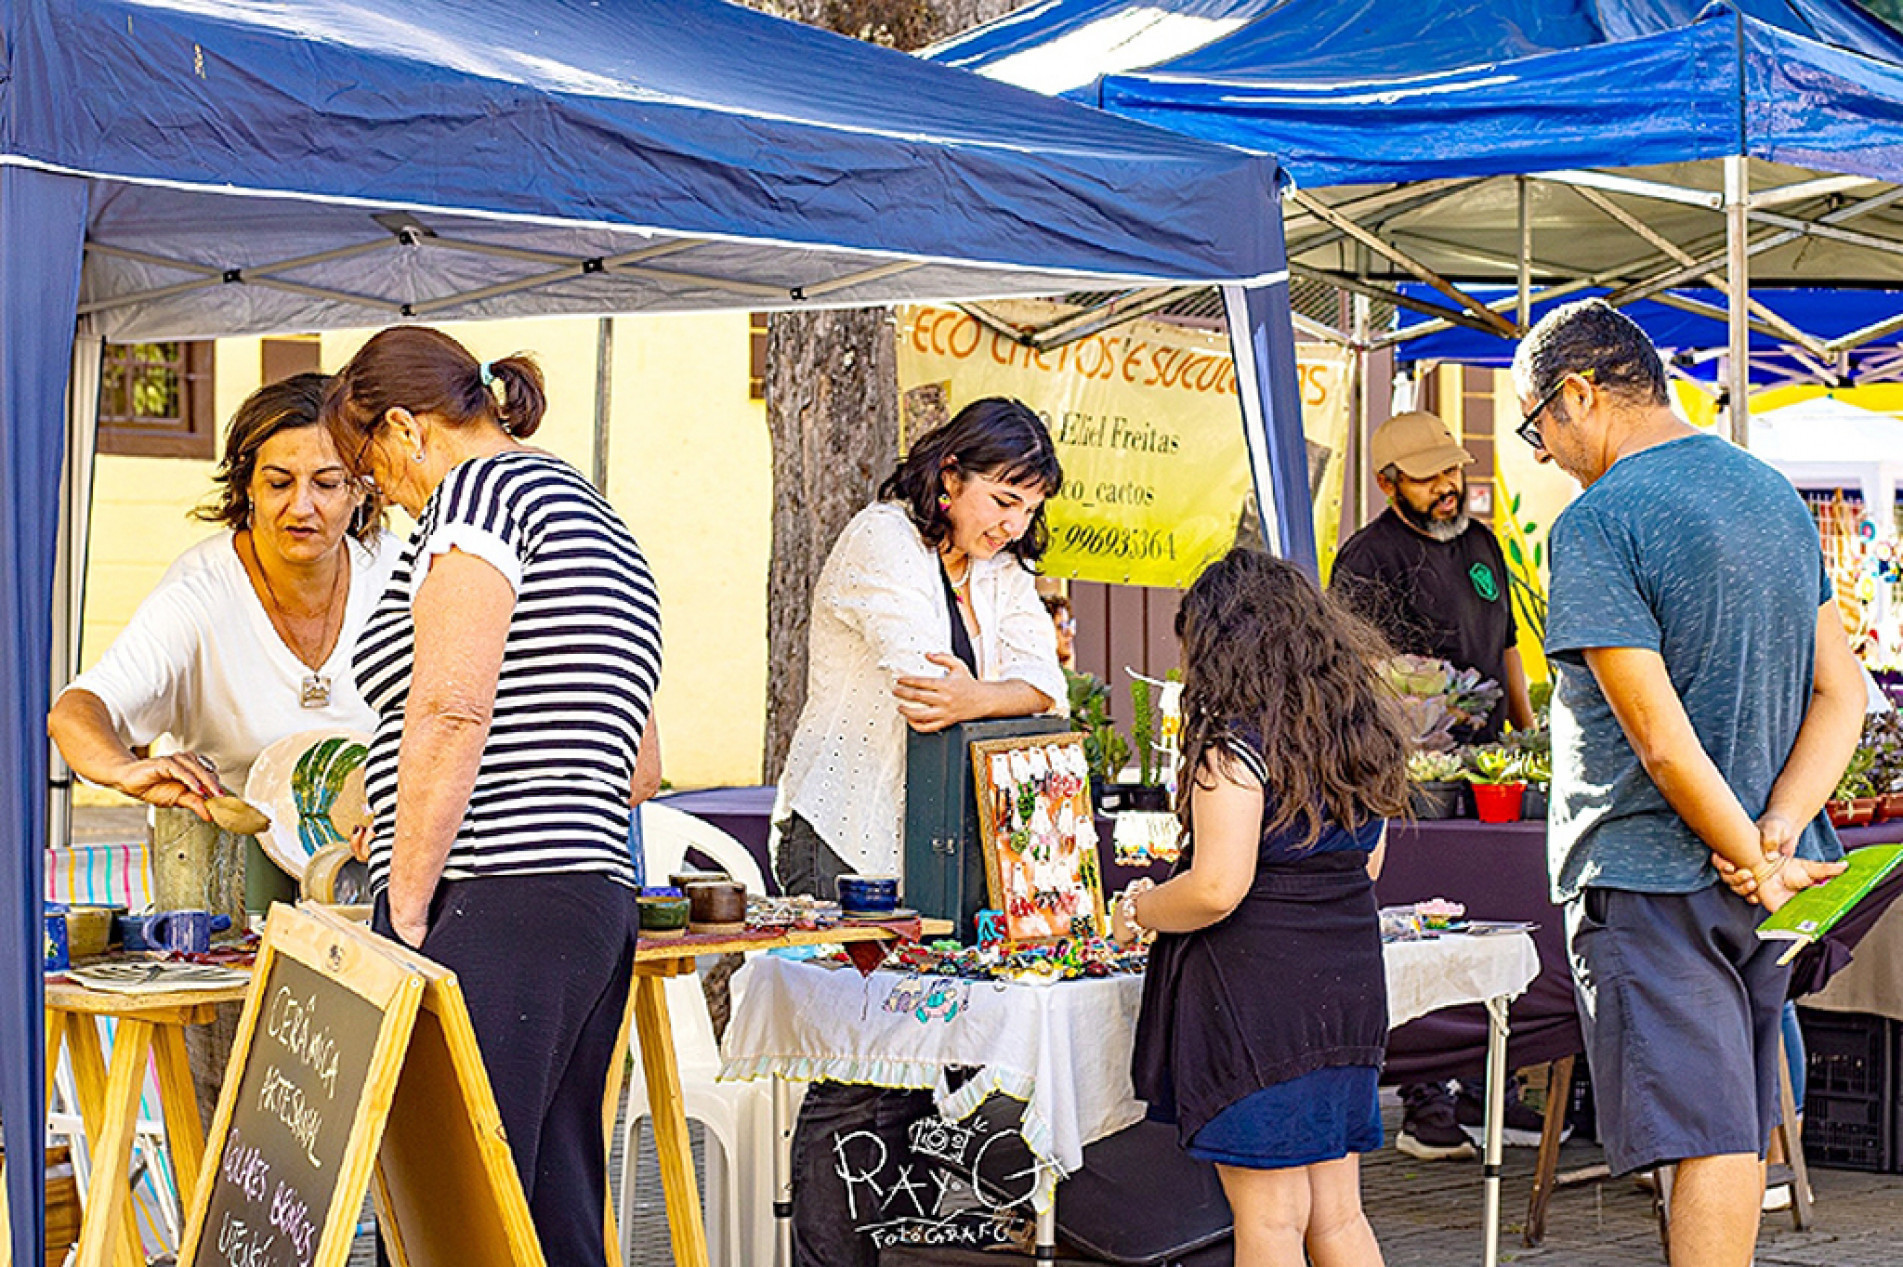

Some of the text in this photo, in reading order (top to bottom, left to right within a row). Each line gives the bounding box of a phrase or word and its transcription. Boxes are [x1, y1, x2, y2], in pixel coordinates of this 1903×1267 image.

[912, 308, 982, 359] ECO
[1122, 342, 1147, 382] E
[1059, 411, 1106, 447] Eliel
[1110, 415, 1181, 454] Freitas
[1060, 479, 1155, 507] co_cactos
